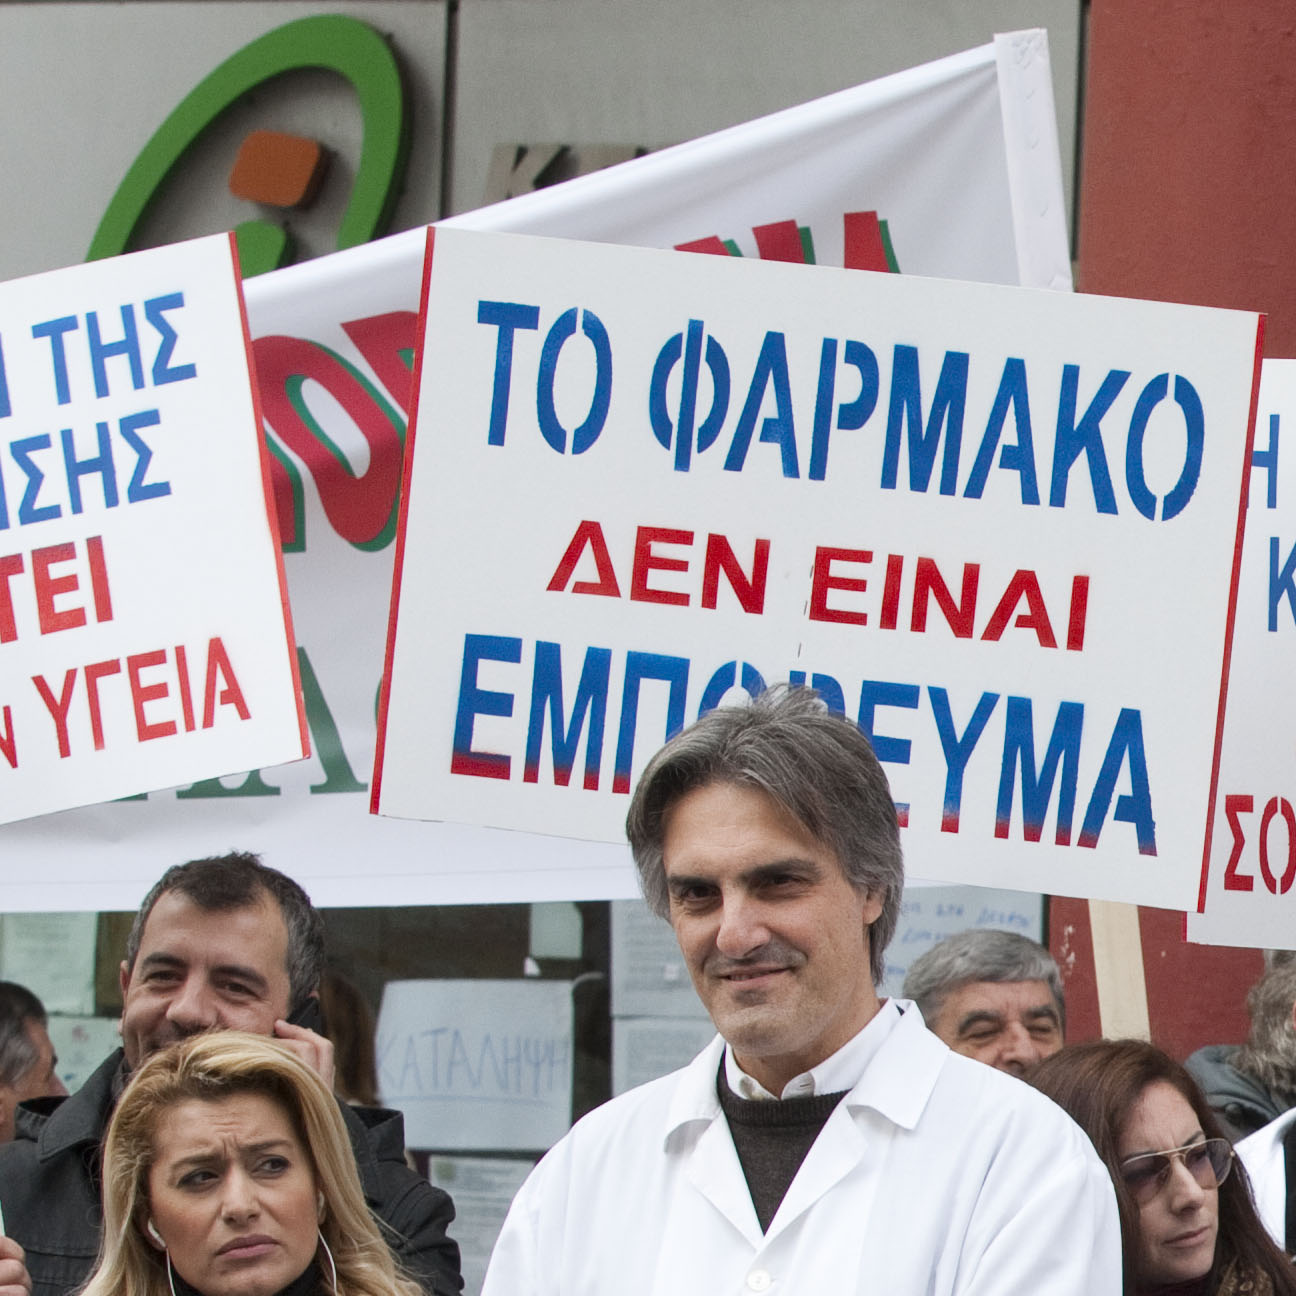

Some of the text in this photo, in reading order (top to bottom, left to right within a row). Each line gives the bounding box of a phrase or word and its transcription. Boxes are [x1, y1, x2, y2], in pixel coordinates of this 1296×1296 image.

[32, 291, 196, 405] ΤΗΣ
[477, 299, 612, 455] ΤΟ
[649, 318, 1204, 520] ΦΑΡΜΑΚΟ
[547, 520, 1089, 651] ΔΕΝ ΕΙΝΑΙ
[32, 638, 250, 758] ΥΓΕΙΑ
